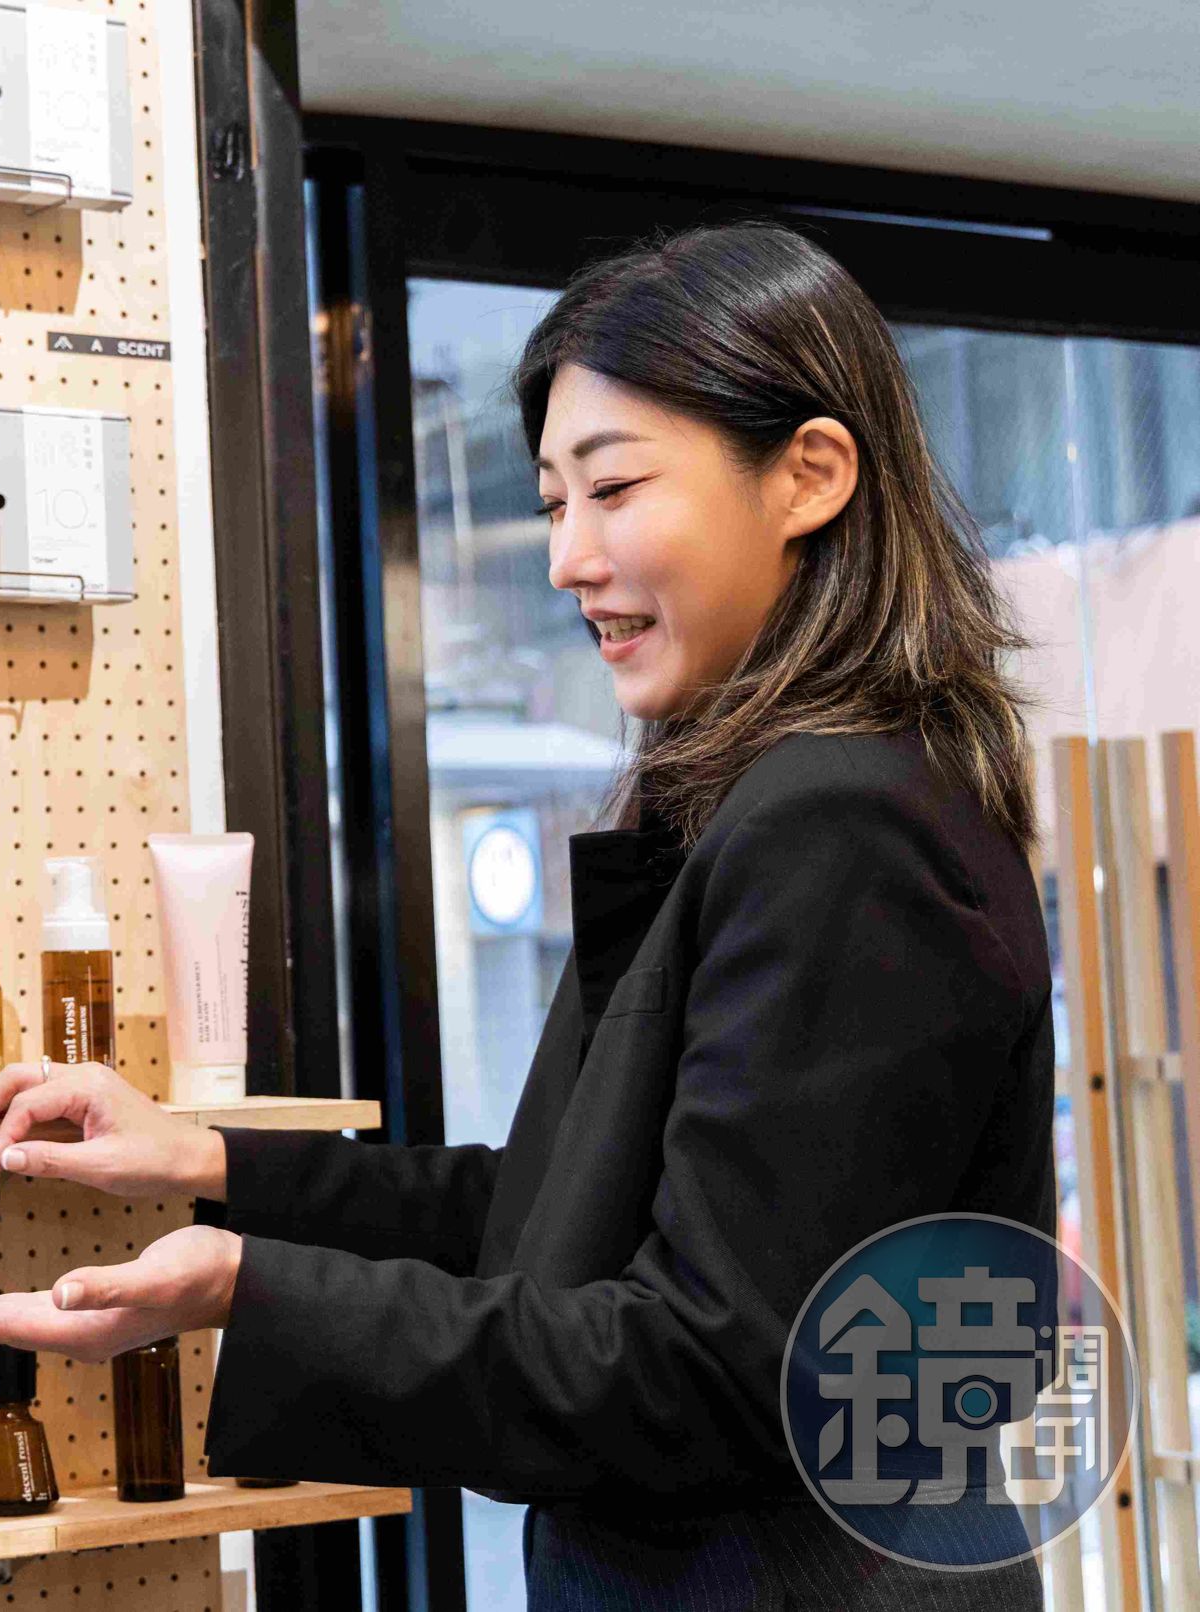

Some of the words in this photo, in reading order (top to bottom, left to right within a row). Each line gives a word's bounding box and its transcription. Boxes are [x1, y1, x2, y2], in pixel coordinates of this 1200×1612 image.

[90, 338, 104, 353] A
[116, 340, 166, 358] SCENT
[60, 996, 76, 1035] rossi
[13, 1430, 26, 1460] rossi
[17, 1462, 33, 1502] decent
